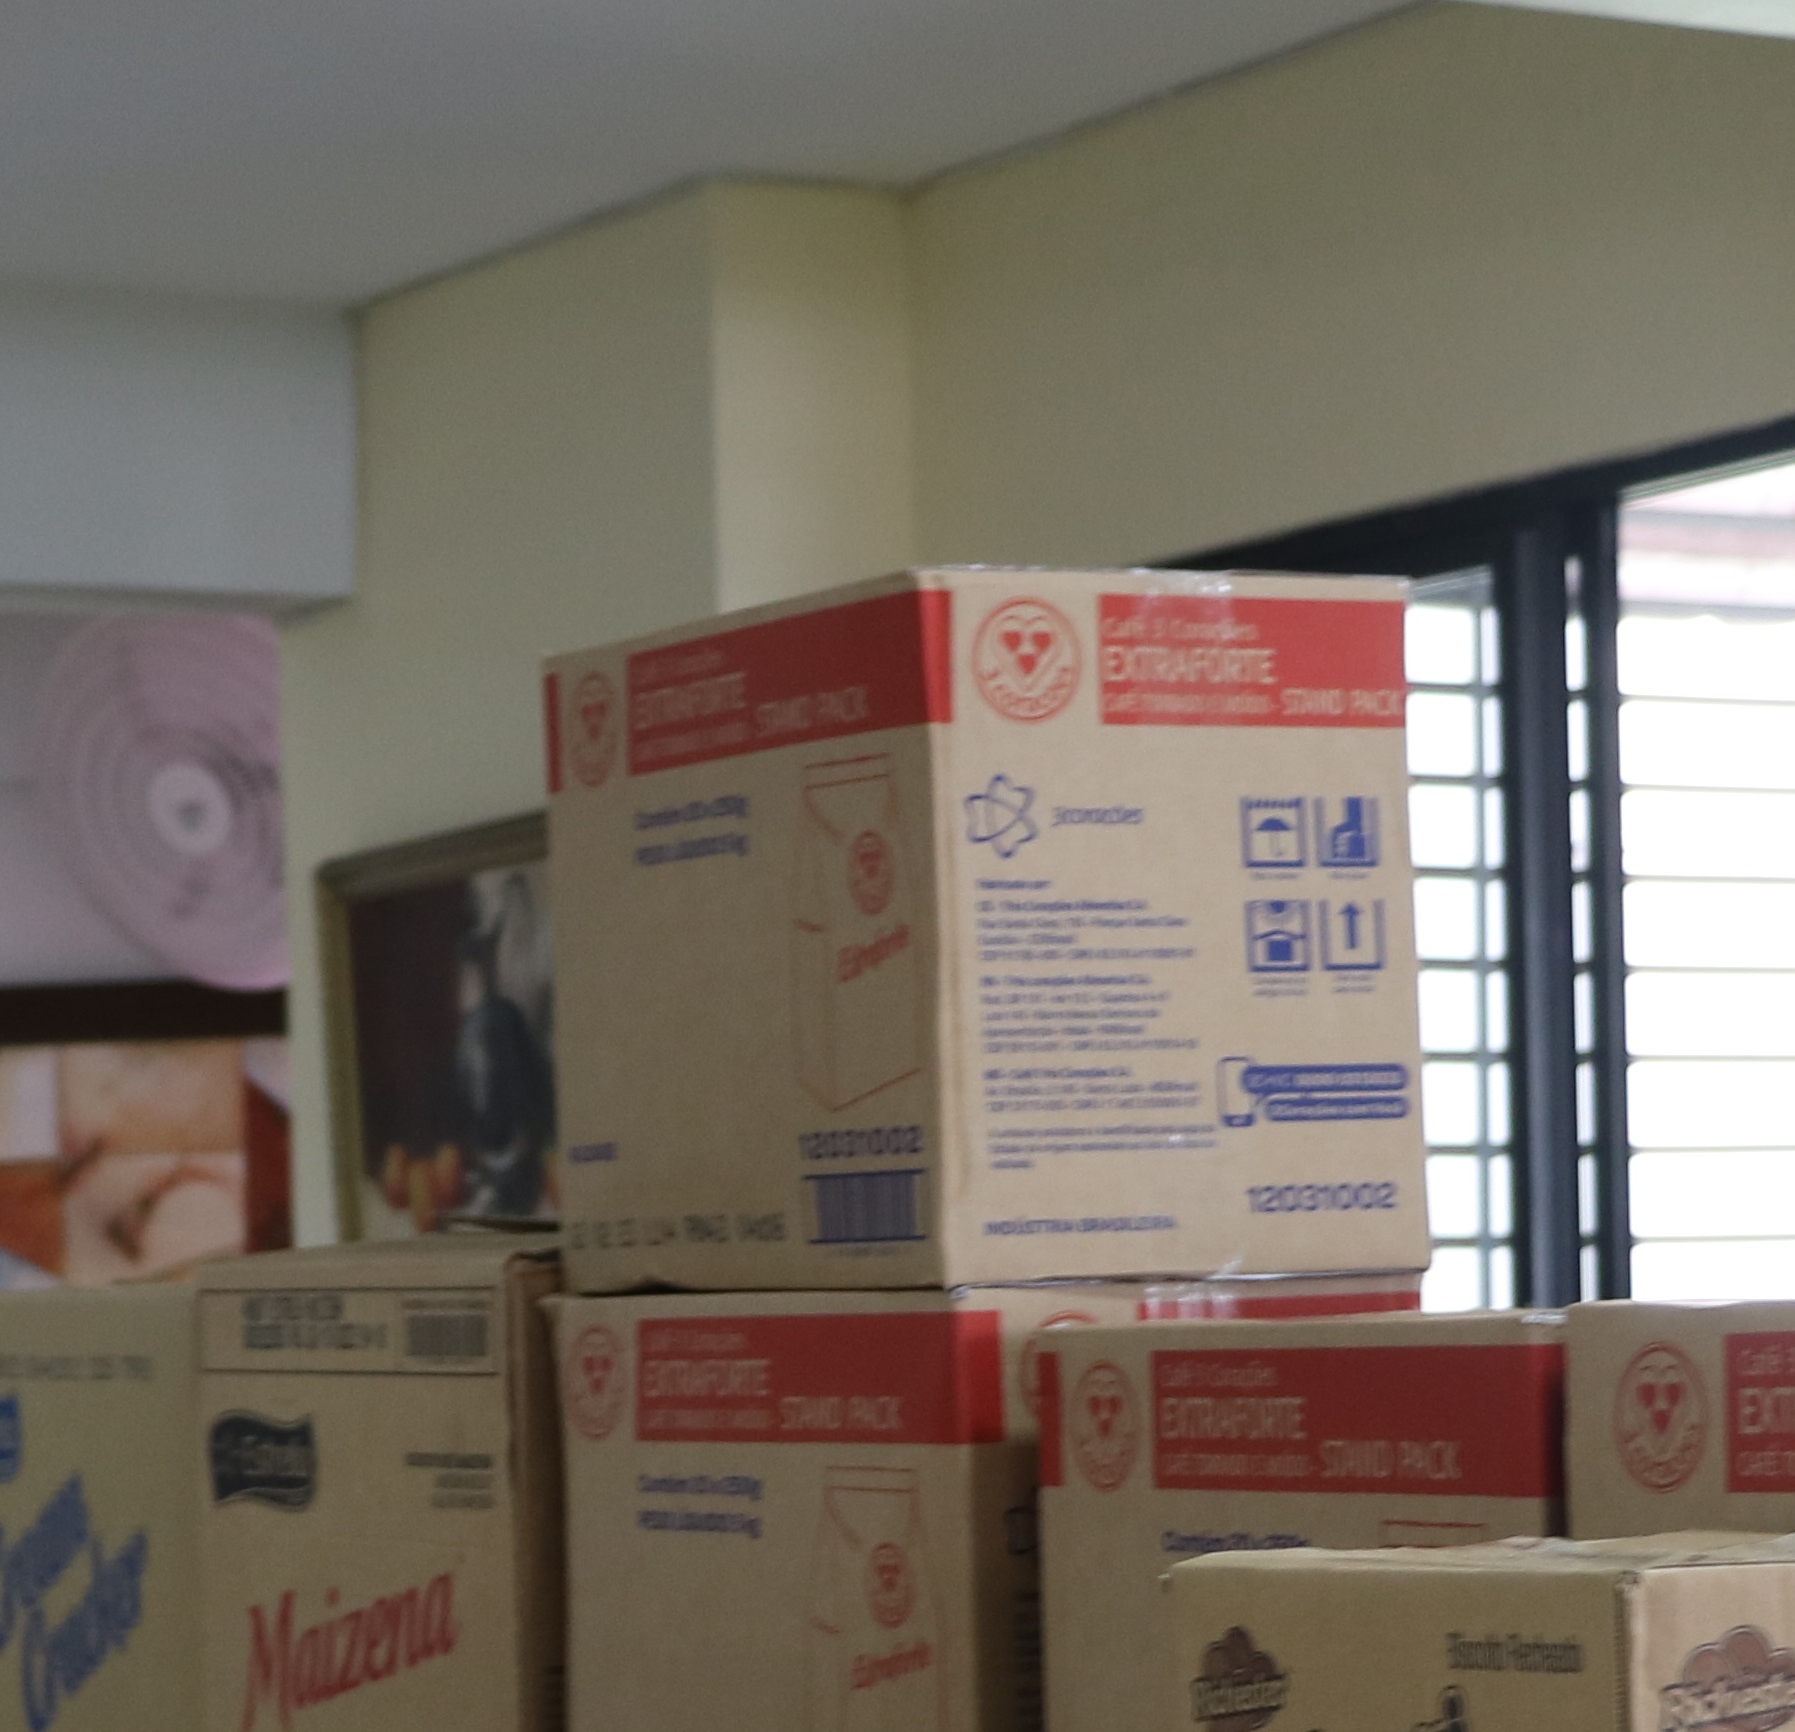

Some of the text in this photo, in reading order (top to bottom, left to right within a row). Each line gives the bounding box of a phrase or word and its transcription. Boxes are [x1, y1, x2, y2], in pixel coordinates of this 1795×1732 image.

[1107, 645, 1278, 683] EXTRAFORTE
[1281, 688, 1344, 716] STAND
[1245, 1181, 1399, 1214] 12031002
[1161, 1396, 1306, 1440] EXTRAFORTE
[1318, 1439, 1393, 1480] STAND
[1400, 1440, 1463, 1480] PACK
